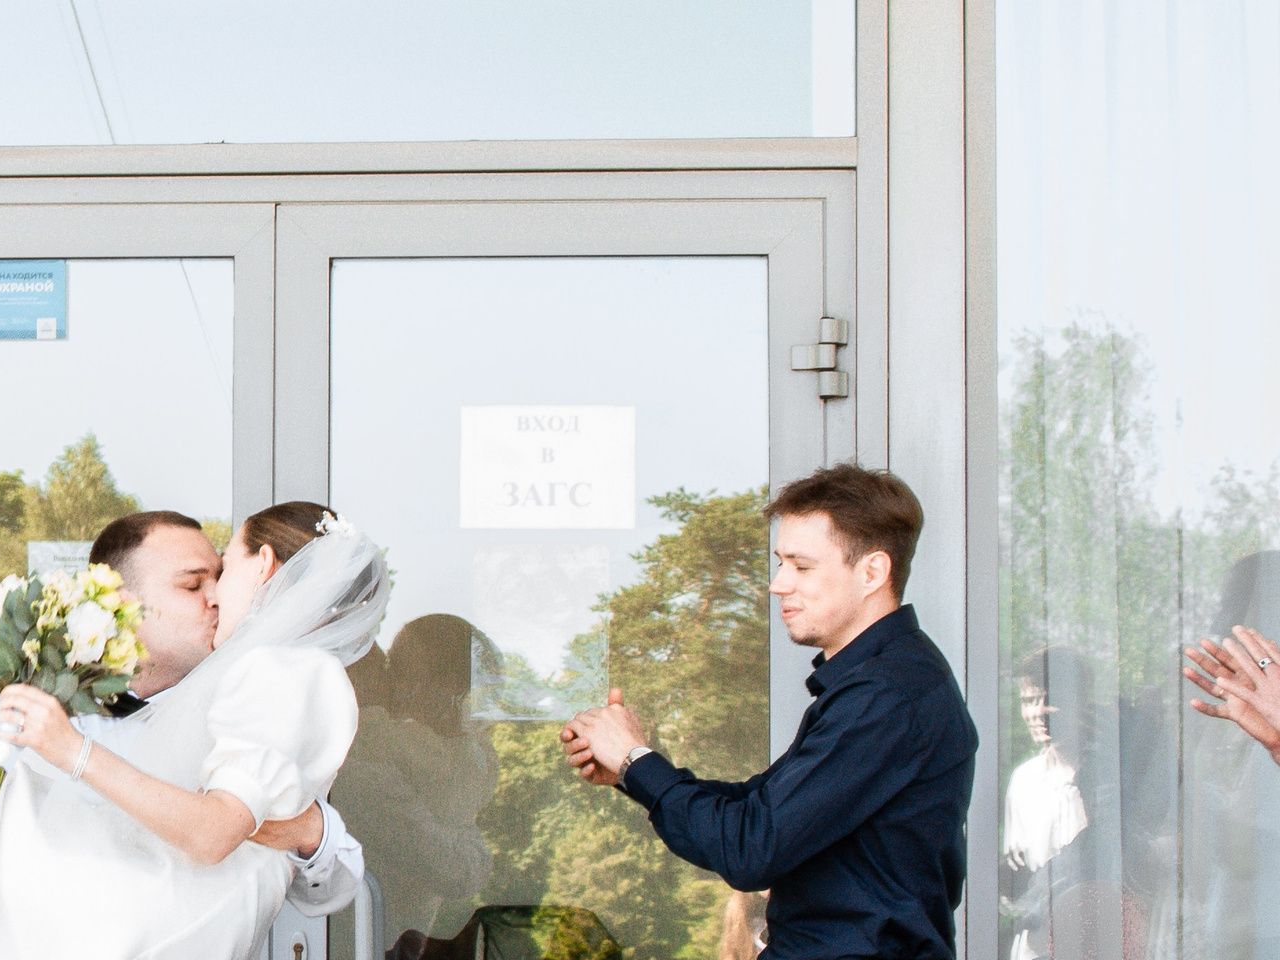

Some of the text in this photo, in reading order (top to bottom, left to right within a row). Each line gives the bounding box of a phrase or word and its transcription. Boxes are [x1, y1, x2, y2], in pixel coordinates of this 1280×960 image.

[0, 272, 53, 280] НАХОДИТСЯ
[517, 415, 580, 433] ВХОД
[541, 447, 555, 464] В
[503, 482, 592, 507] ЗАГС
